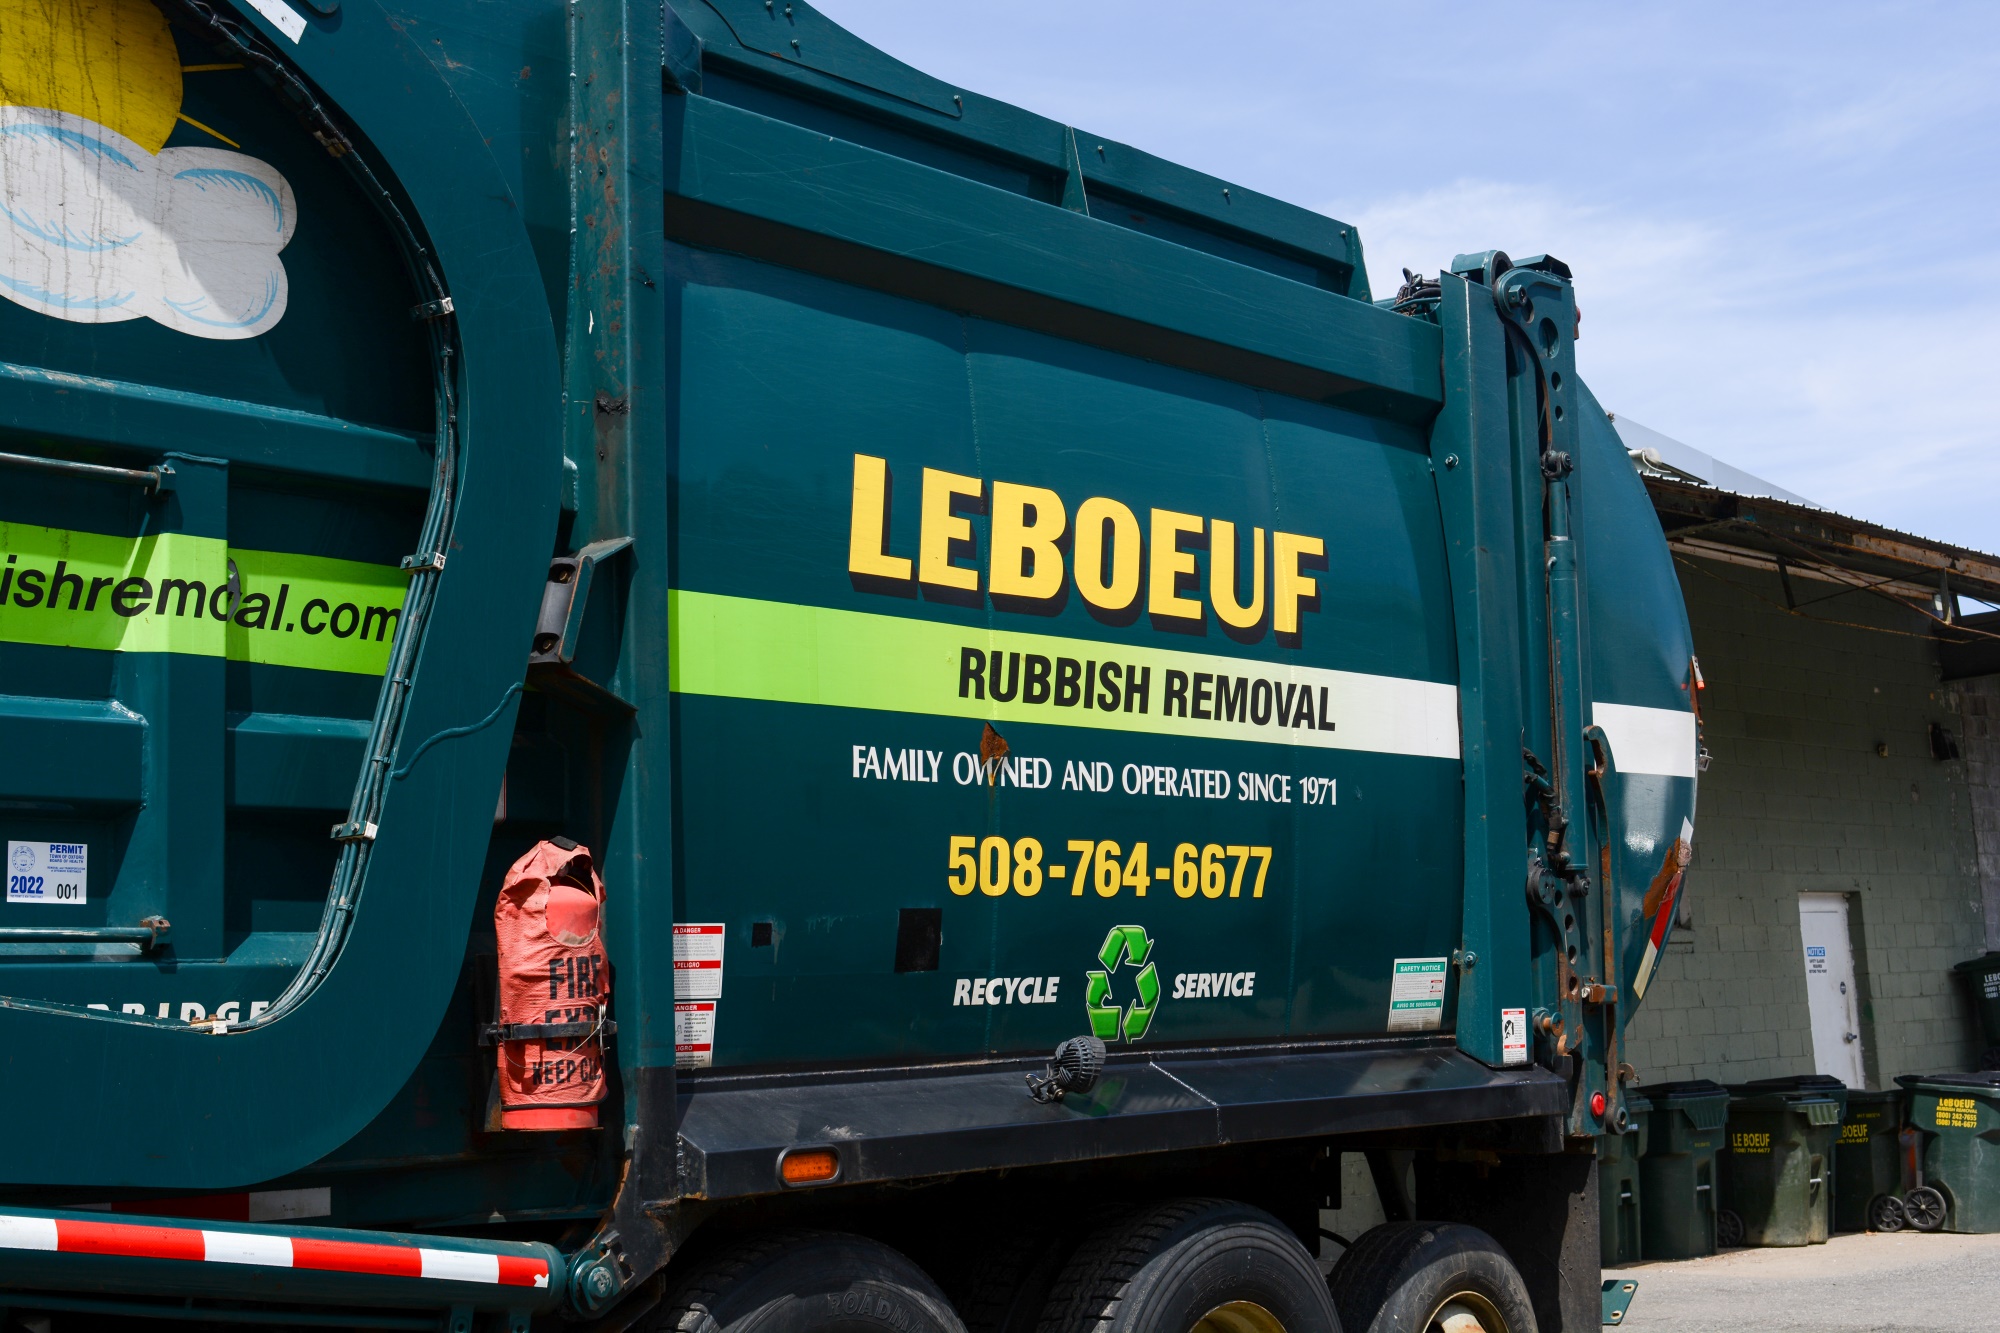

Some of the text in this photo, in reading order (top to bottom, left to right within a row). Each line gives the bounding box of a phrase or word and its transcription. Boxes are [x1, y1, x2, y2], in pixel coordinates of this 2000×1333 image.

[848, 453, 1328, 650] LEBOEUF
[958, 646, 1336, 732] RUBBISH REMOVAL
[852, 744, 1338, 806] FAMILY OWNED AND OPERATED SINCE 1971
[50, 844, 83, 854] PERMIT
[947, 835, 1273, 899] 508-764-6677
[10, 875, 43, 894] 2022
[57, 884, 78, 899] 001
[953, 976, 1060, 1006] RECYCLE
[1172, 972, 1256, 999] SERVICE
[533, 1060, 577, 1085] KEEP
[1733, 1133, 1770, 1147] LE BOEUF
